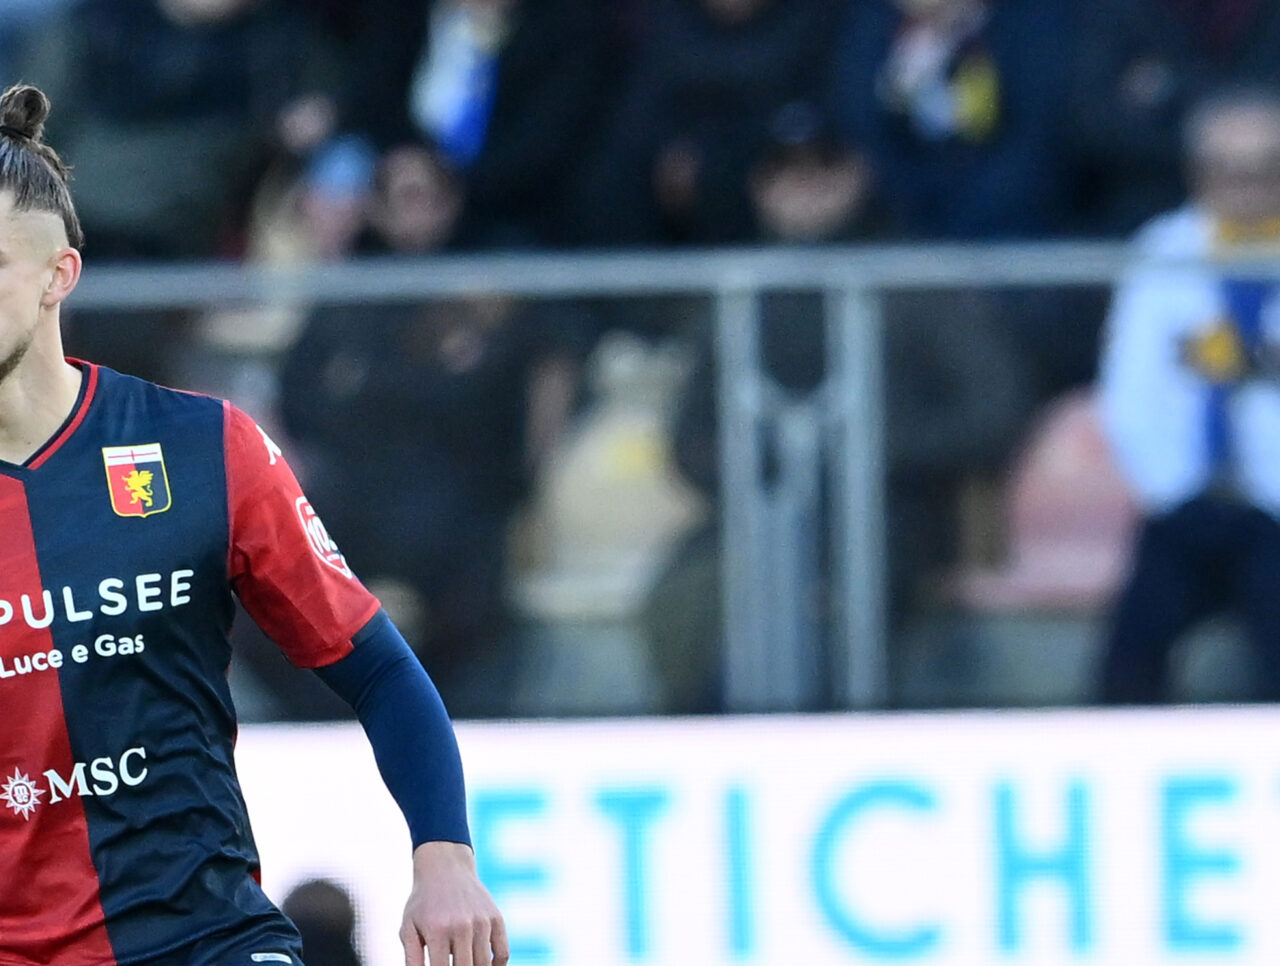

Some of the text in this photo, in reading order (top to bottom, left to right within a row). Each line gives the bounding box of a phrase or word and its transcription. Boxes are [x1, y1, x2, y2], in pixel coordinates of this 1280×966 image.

[71, 644, 89, 663] e
[94, 634, 145, 657] Gas
[42, 747, 148, 804] MSC
[472, 770, 1280, 966] ETICHE
